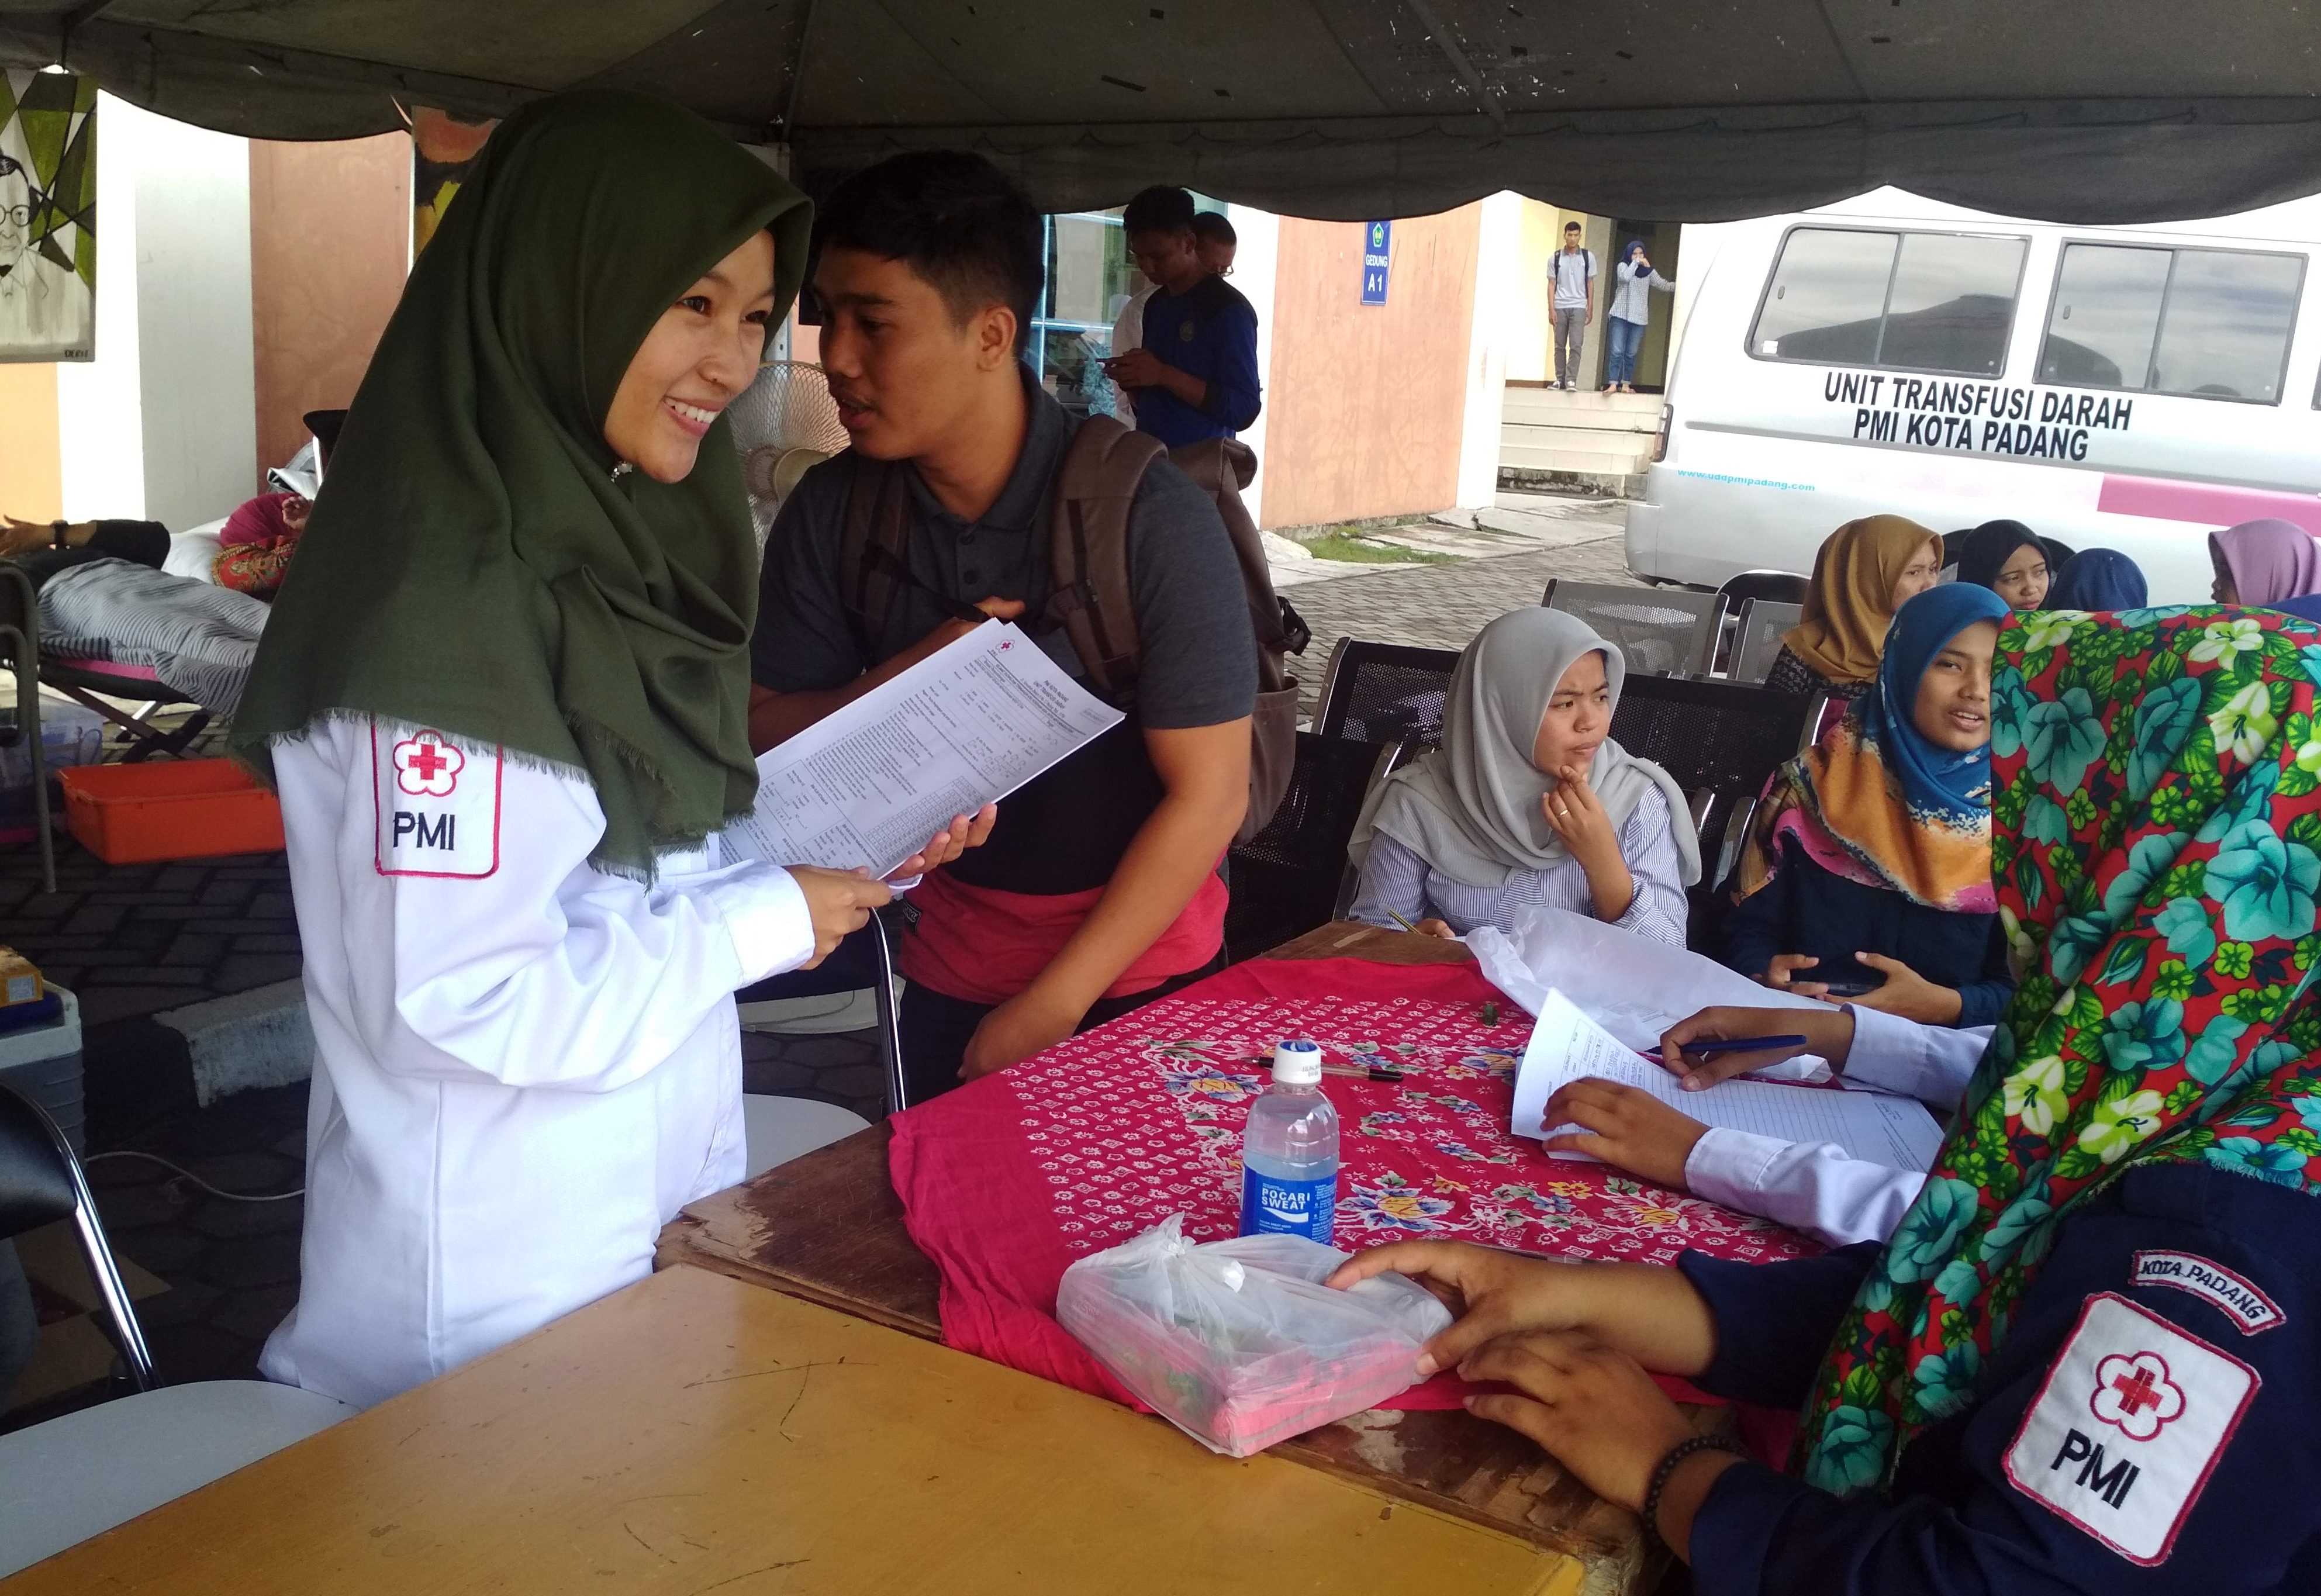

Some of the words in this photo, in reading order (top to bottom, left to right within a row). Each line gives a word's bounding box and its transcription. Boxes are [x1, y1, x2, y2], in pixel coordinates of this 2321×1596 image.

[1365, 254, 1388, 268] GEDUNG
[1825, 371, 1885, 406] UNIT
[1892, 377, 2035, 421] TRANSFUSI
[2040, 391, 2133, 431] DARAH
[1853, 408, 1900, 443] PMI
[1905, 413, 1973, 450] KOTA
[1981, 420, 2089, 461] PADANG
[1677, 469, 1815, 492] www.uddpmipadang.com
[393, 811, 455, 851] PMI
[1262, 1187, 1310, 1201] POCARI
[1262, 1196, 1306, 1210] SWEAT
[2140, 1260, 2182, 1276] KOTA
[2187, 1264, 2267, 1319] PADANG
[2050, 1428, 2141, 1510] PMI
